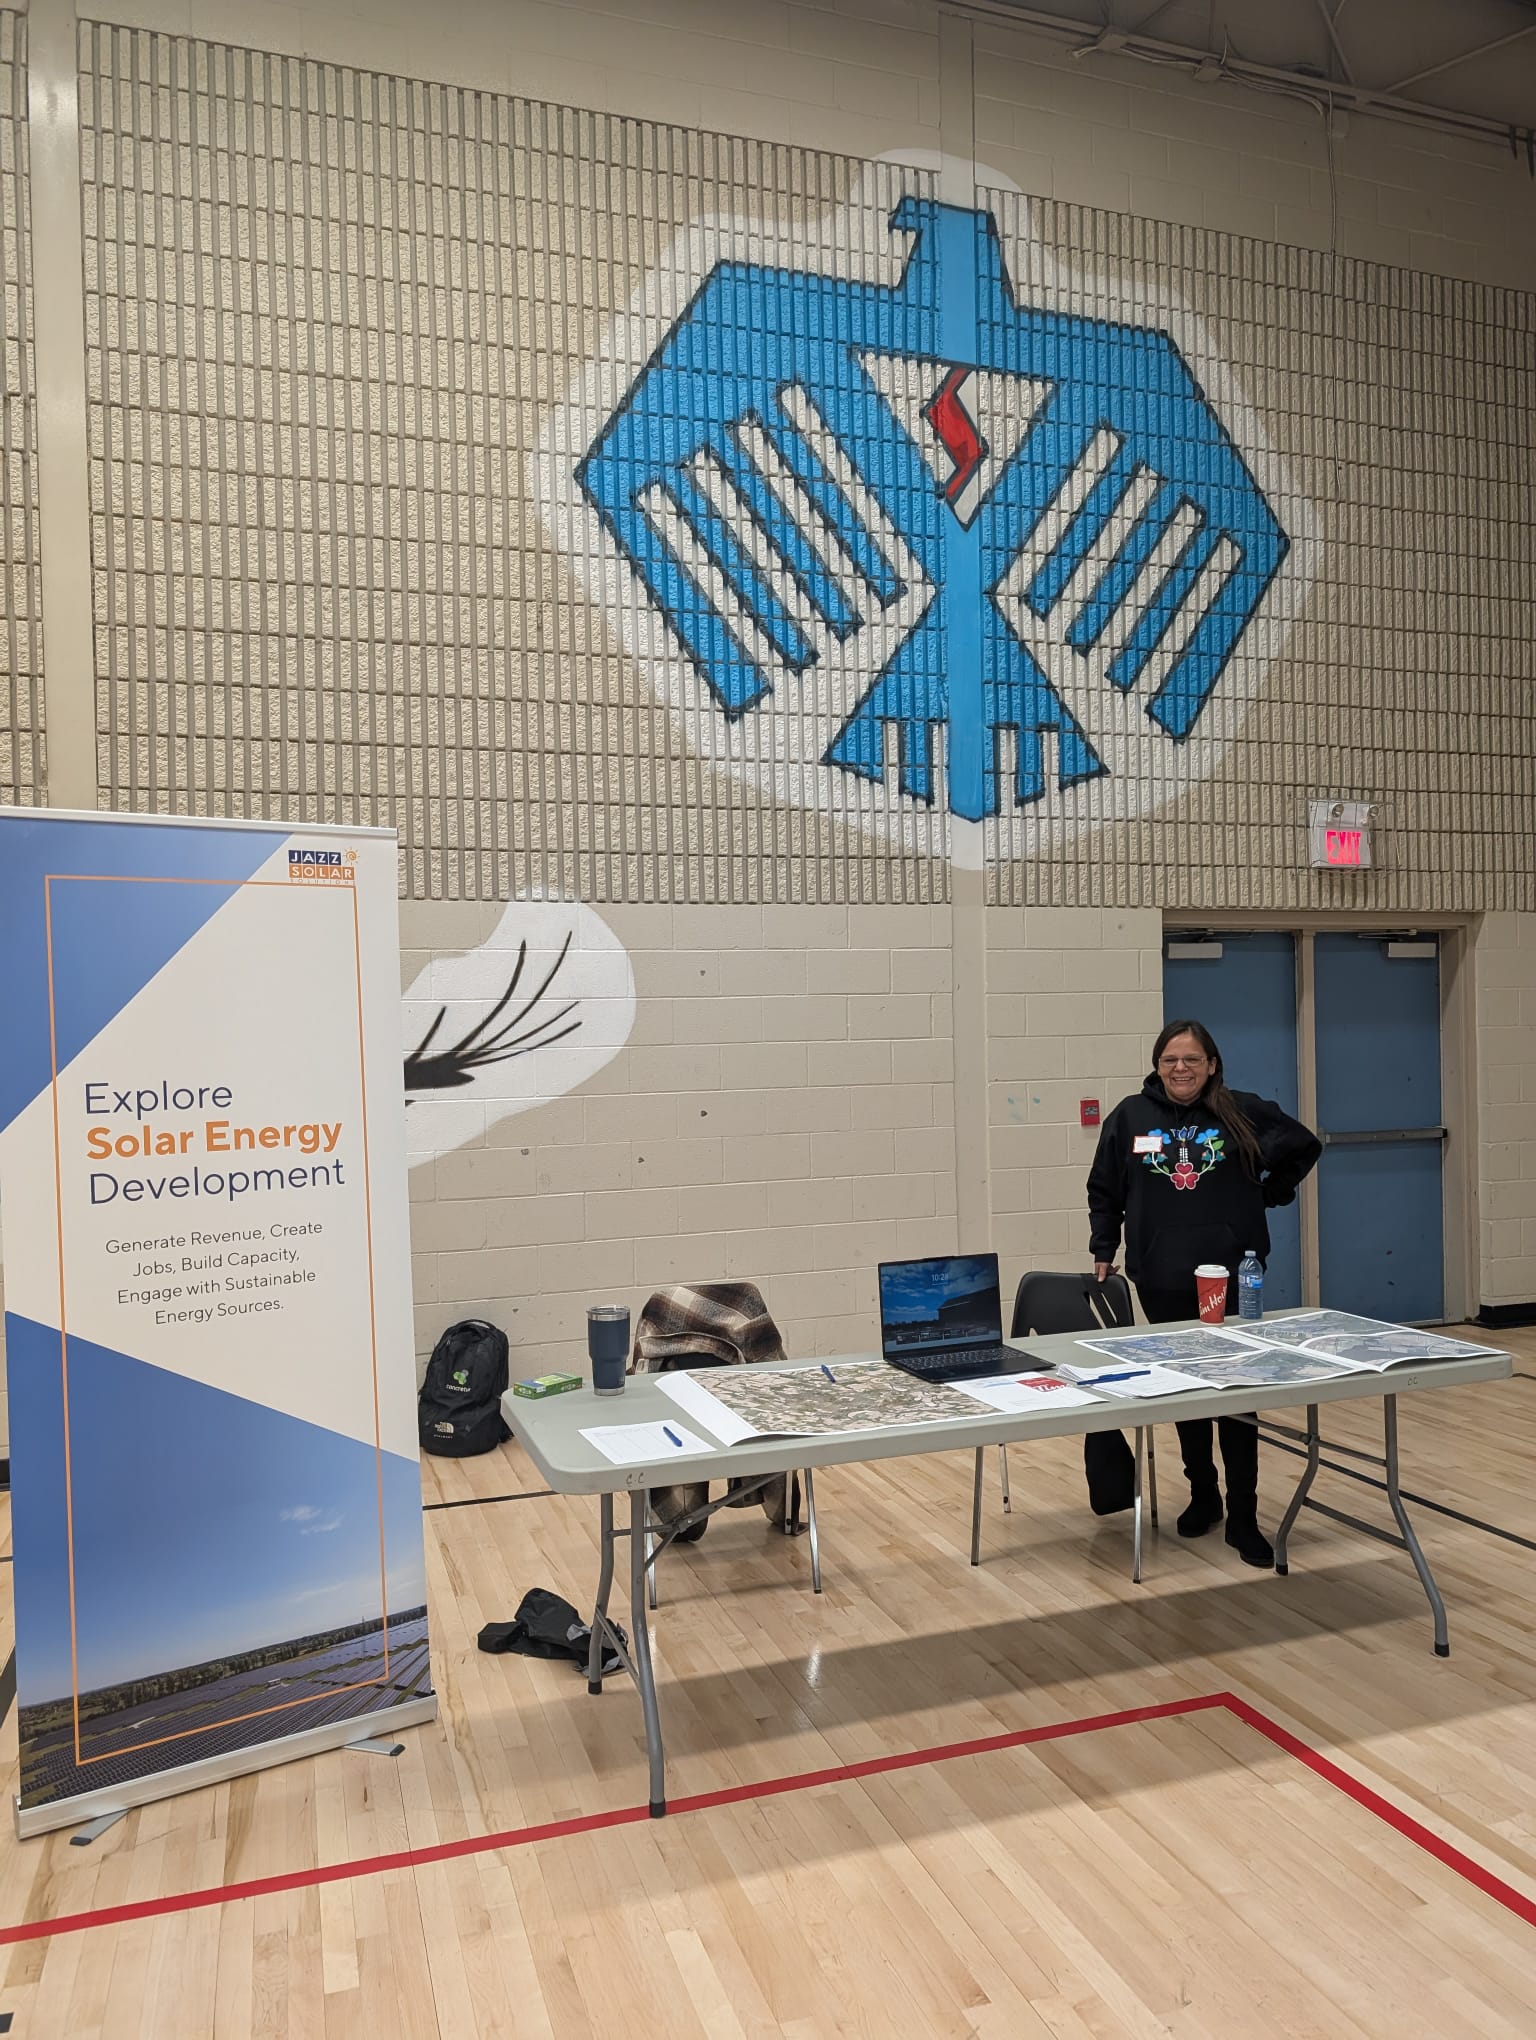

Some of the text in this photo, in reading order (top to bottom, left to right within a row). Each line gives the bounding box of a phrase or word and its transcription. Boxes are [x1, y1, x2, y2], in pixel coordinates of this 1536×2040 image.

[289, 851, 340, 864] JAZZ
[1326, 831, 1361, 865] EXIT
[291, 866, 353, 879] SOLAR
[85, 1080, 233, 1120] Explore
[86, 1120, 343, 1160] Solar Energy
[89, 1158, 345, 1205] Development
[105, 1221, 323, 1254] Generate Revenue, Create
[132, 1247, 300, 1278] Jobs, Build Capacity,
[117, 1270, 316, 1305] Engage with Sustainable
[155, 1298, 284, 1326] Energy Sources.
